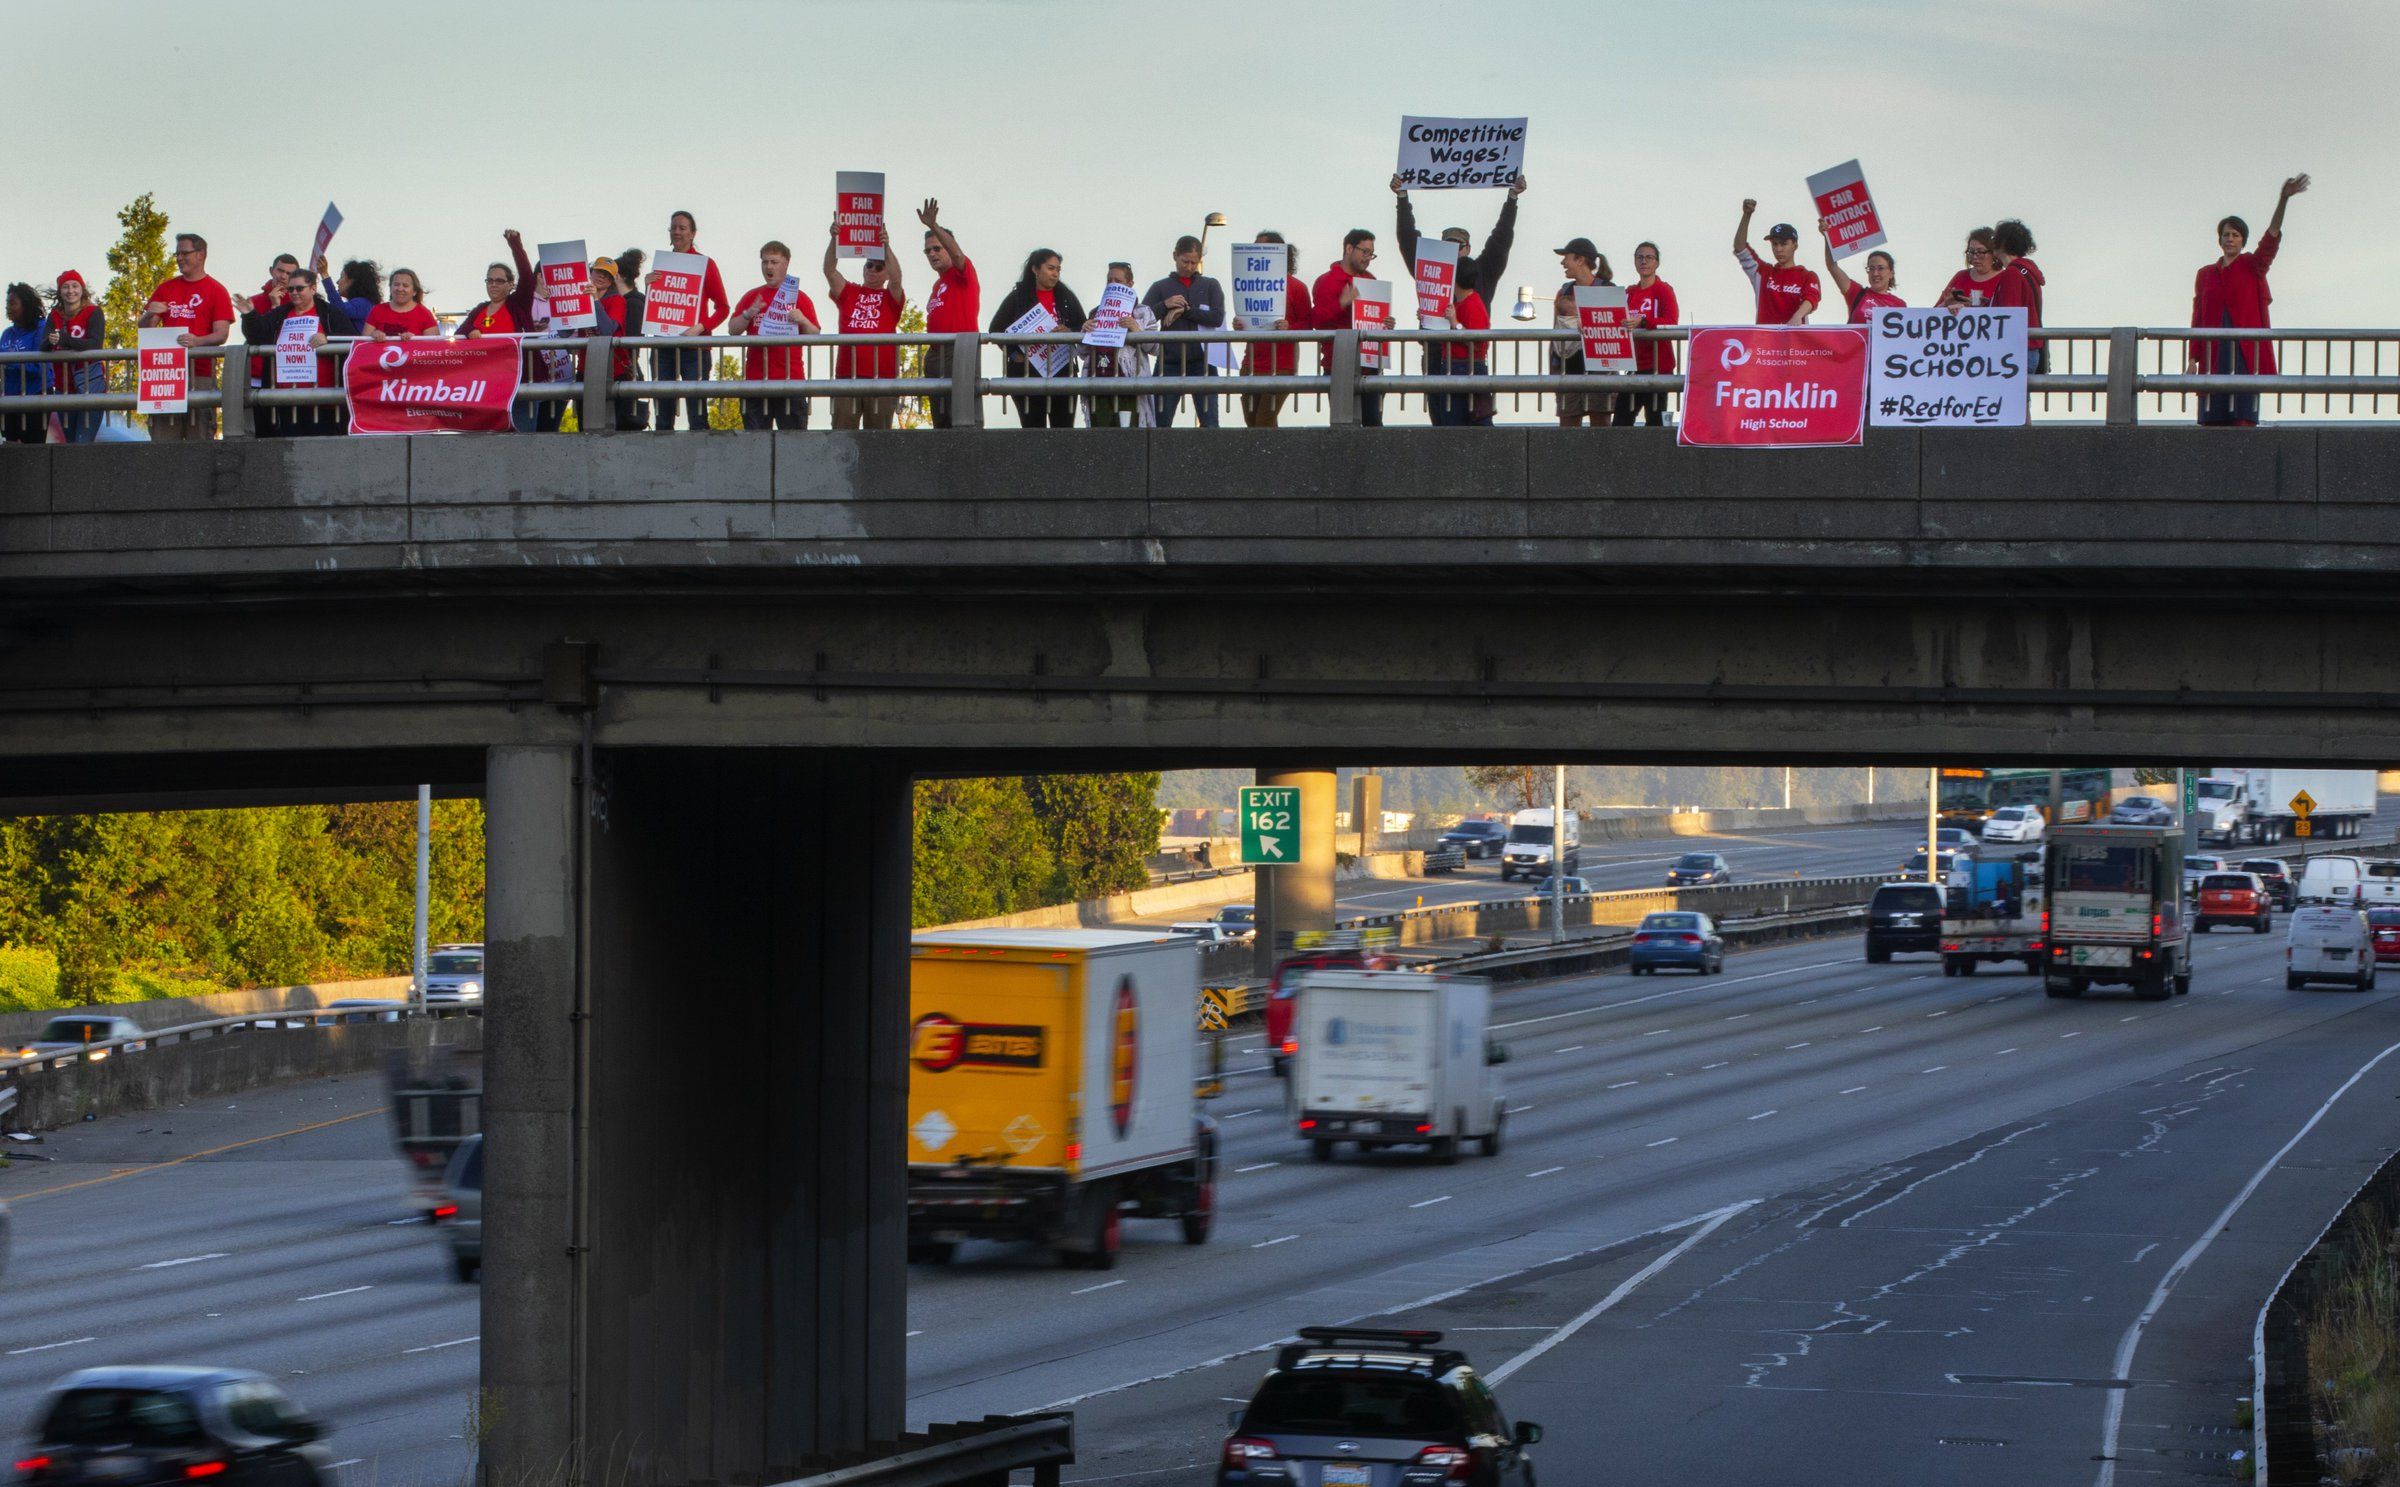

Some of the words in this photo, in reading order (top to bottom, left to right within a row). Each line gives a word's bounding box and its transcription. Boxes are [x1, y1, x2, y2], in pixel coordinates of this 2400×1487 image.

[1408, 124, 1523, 146] Competitive
[1430, 145, 1509, 167] Wages!
[1400, 165, 1519, 186] #RedforEd
[852, 197, 873, 210] FAIR
[1830, 189, 1855, 208] FAIR
[839, 212, 883, 227] CONTRACT
[1823, 201, 1872, 229] CONTRACT
[850, 229, 875, 243] NOW!
[1839, 220, 1868, 241] NOW!
[1247, 257, 1271, 272] Fair
[1423, 264, 1442, 279] FAIR
[552, 267, 574, 281] FAIR
[664, 275, 688, 290] FAIR
[1233, 277, 1285, 292] Contract
[648, 289, 699, 307] CONTRACT
[1104, 298, 1122, 308] FAIR
[1244, 298, 1274, 312] Now!
[555, 299, 580, 313] NOW!
[1363, 304, 1380, 318] FAIR
[285, 317, 315, 326] Seattle
[657, 306, 686, 322] NOW!
[1011, 307, 1042, 334] Seattle
[1591, 311, 1615, 324] FAIR
[1583, 326, 1629, 339] CONTRACT
[1882, 311, 2011, 341] SUPPORT
[288, 332, 305, 342] FAIR
[1594, 342, 1621, 355] NOW!
[1923, 342, 1970, 357] our
[152, 352, 174, 366] FAIR
[285, 355, 306, 364] NOW!
[1755, 358, 1807, 366] ASSOCIATION
[1884, 353, 2019, 379] SCHOOLS
[141, 368, 186, 381] CONTRACT
[150, 384, 175, 397] NOW!
[380, 379, 487, 402] Kimball
[1715, 381, 1838, 409] Franklin
[406, 408, 464, 419] Elementary
[1880, 394, 2003, 418] #RedforEd
[1740, 418, 1766, 431] High
[1768, 418, 1808, 429] School
[1249, 792, 1292, 807] EXIT
[1249, 811, 1291, 830] 162
[2296, 822, 2310, 831] 25
